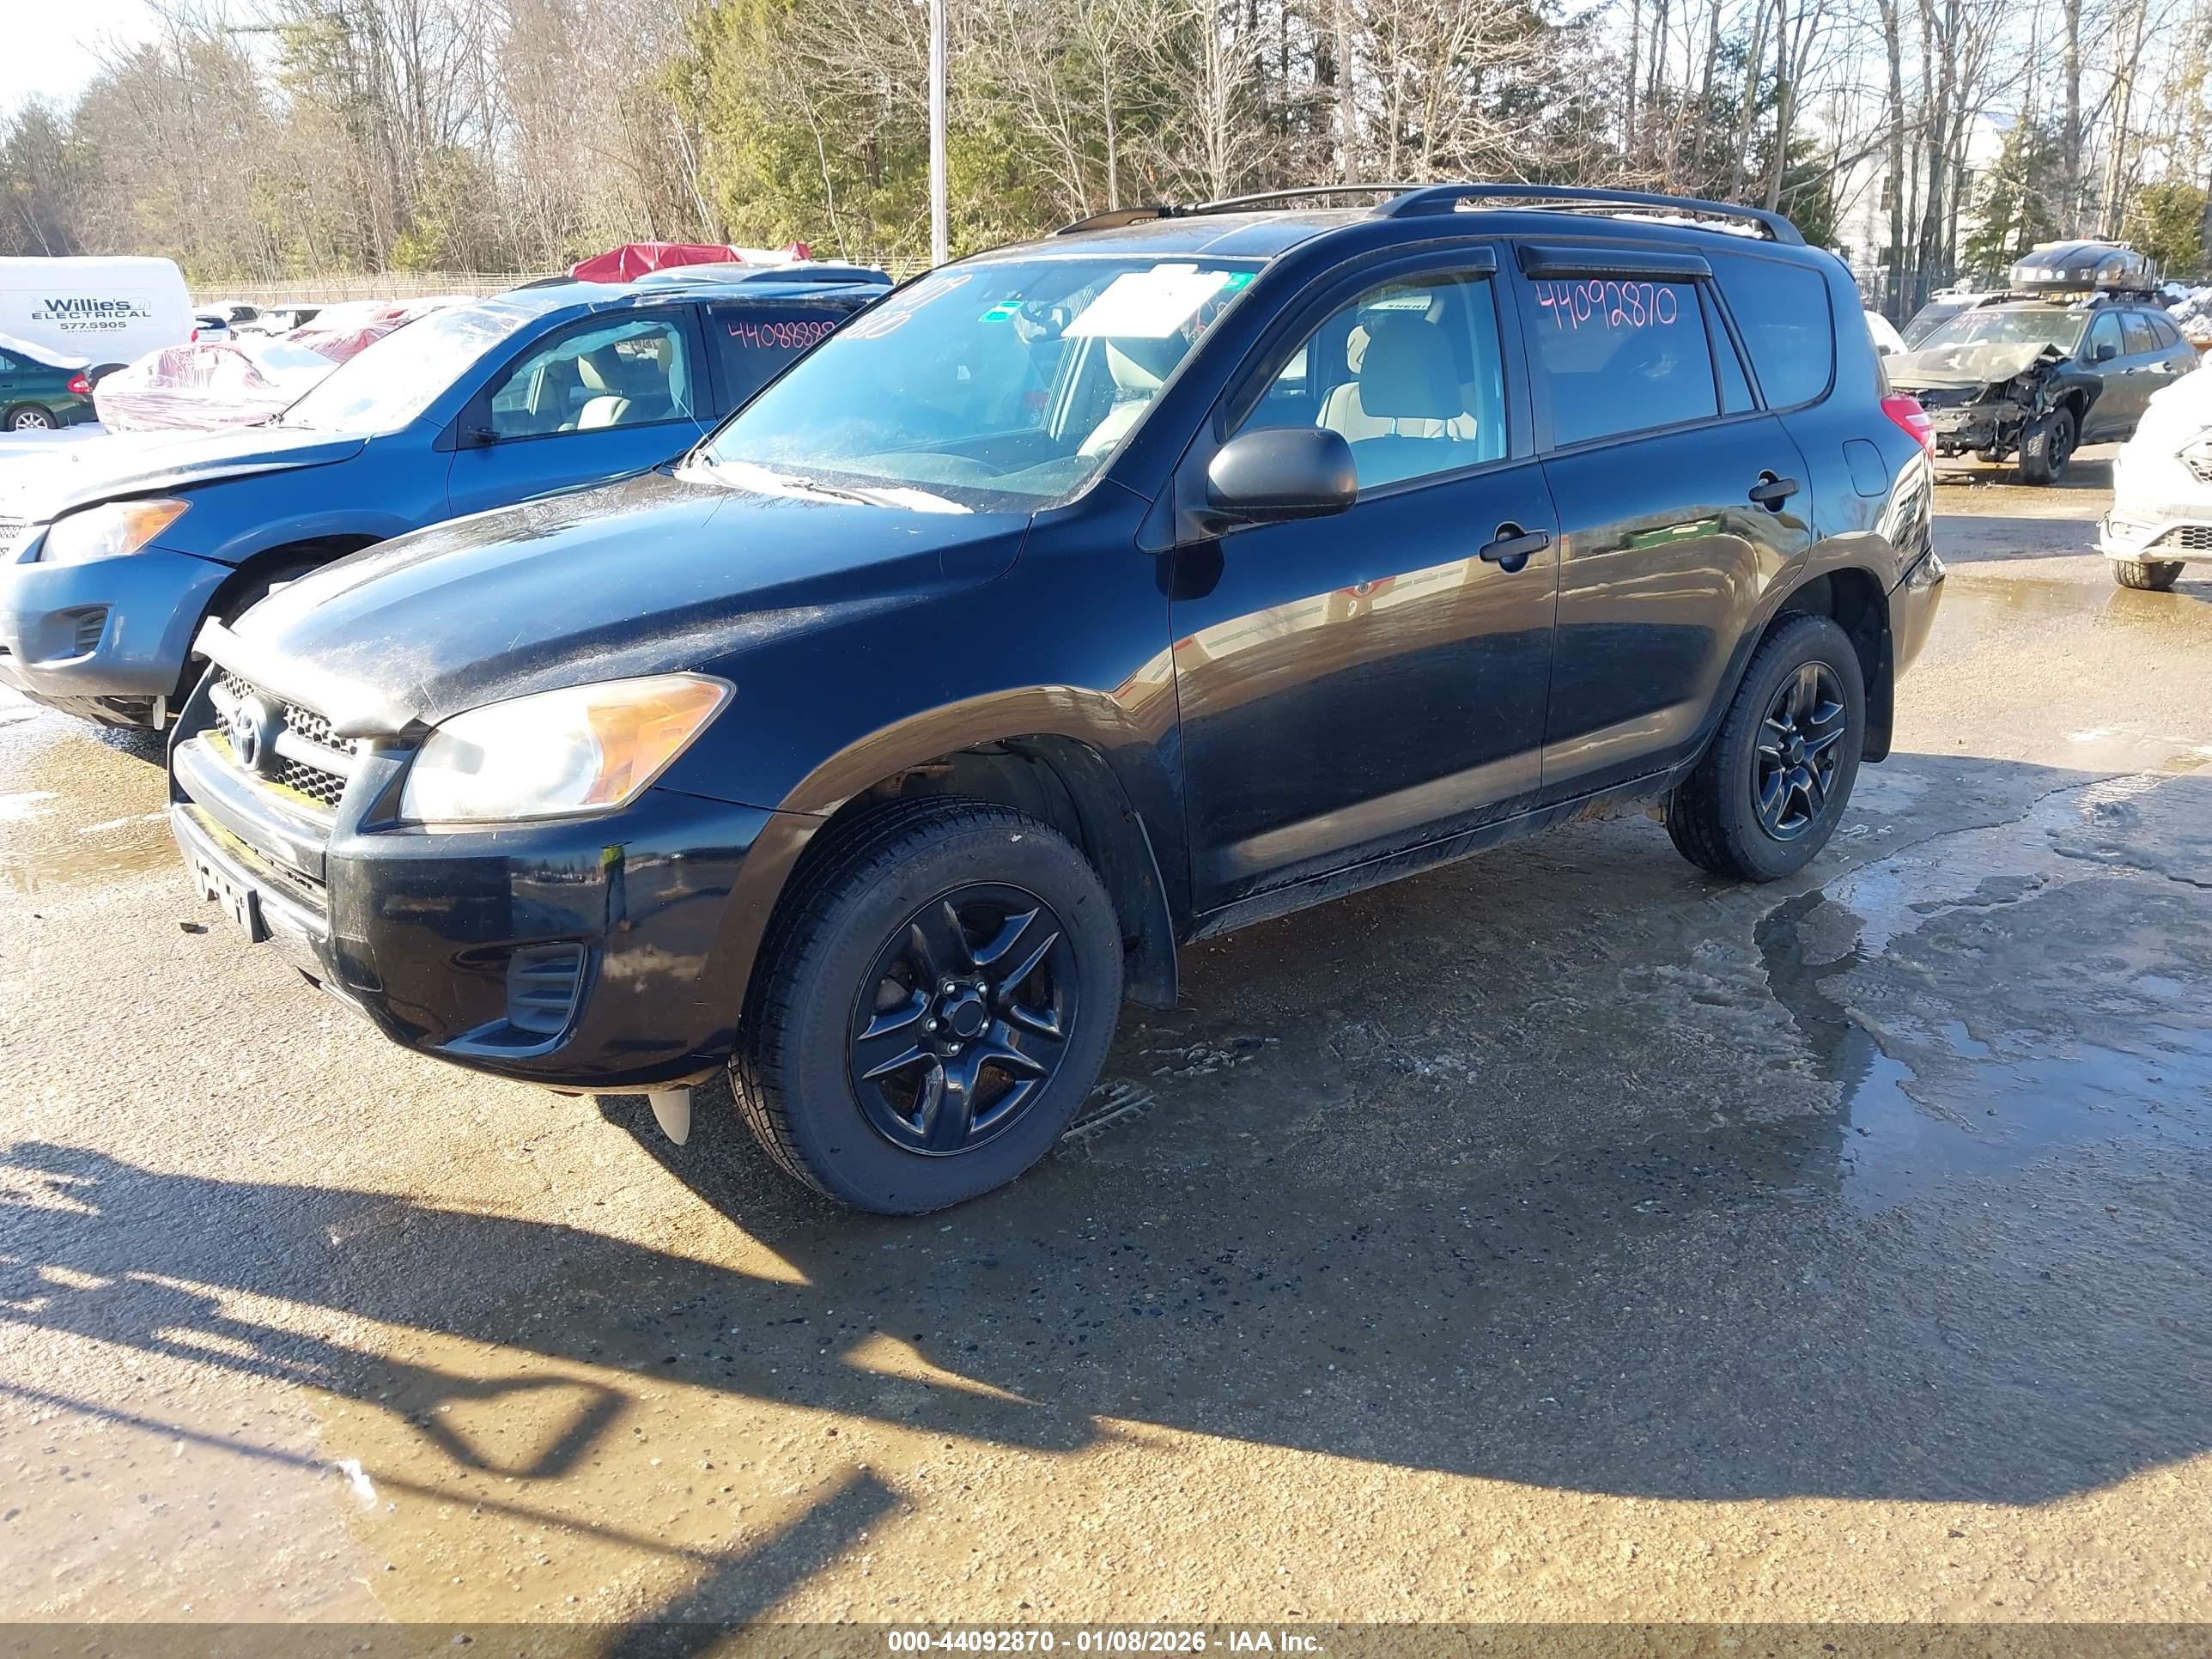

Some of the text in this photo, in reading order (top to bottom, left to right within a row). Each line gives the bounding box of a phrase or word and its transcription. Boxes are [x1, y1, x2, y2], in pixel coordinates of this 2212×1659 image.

[44, 298, 131, 312] Willie's
[1535, 279, 1677, 331] 44092870
[31, 310, 152, 320] ELECTRICAL
[59, 321, 127, 330] 577.5905
